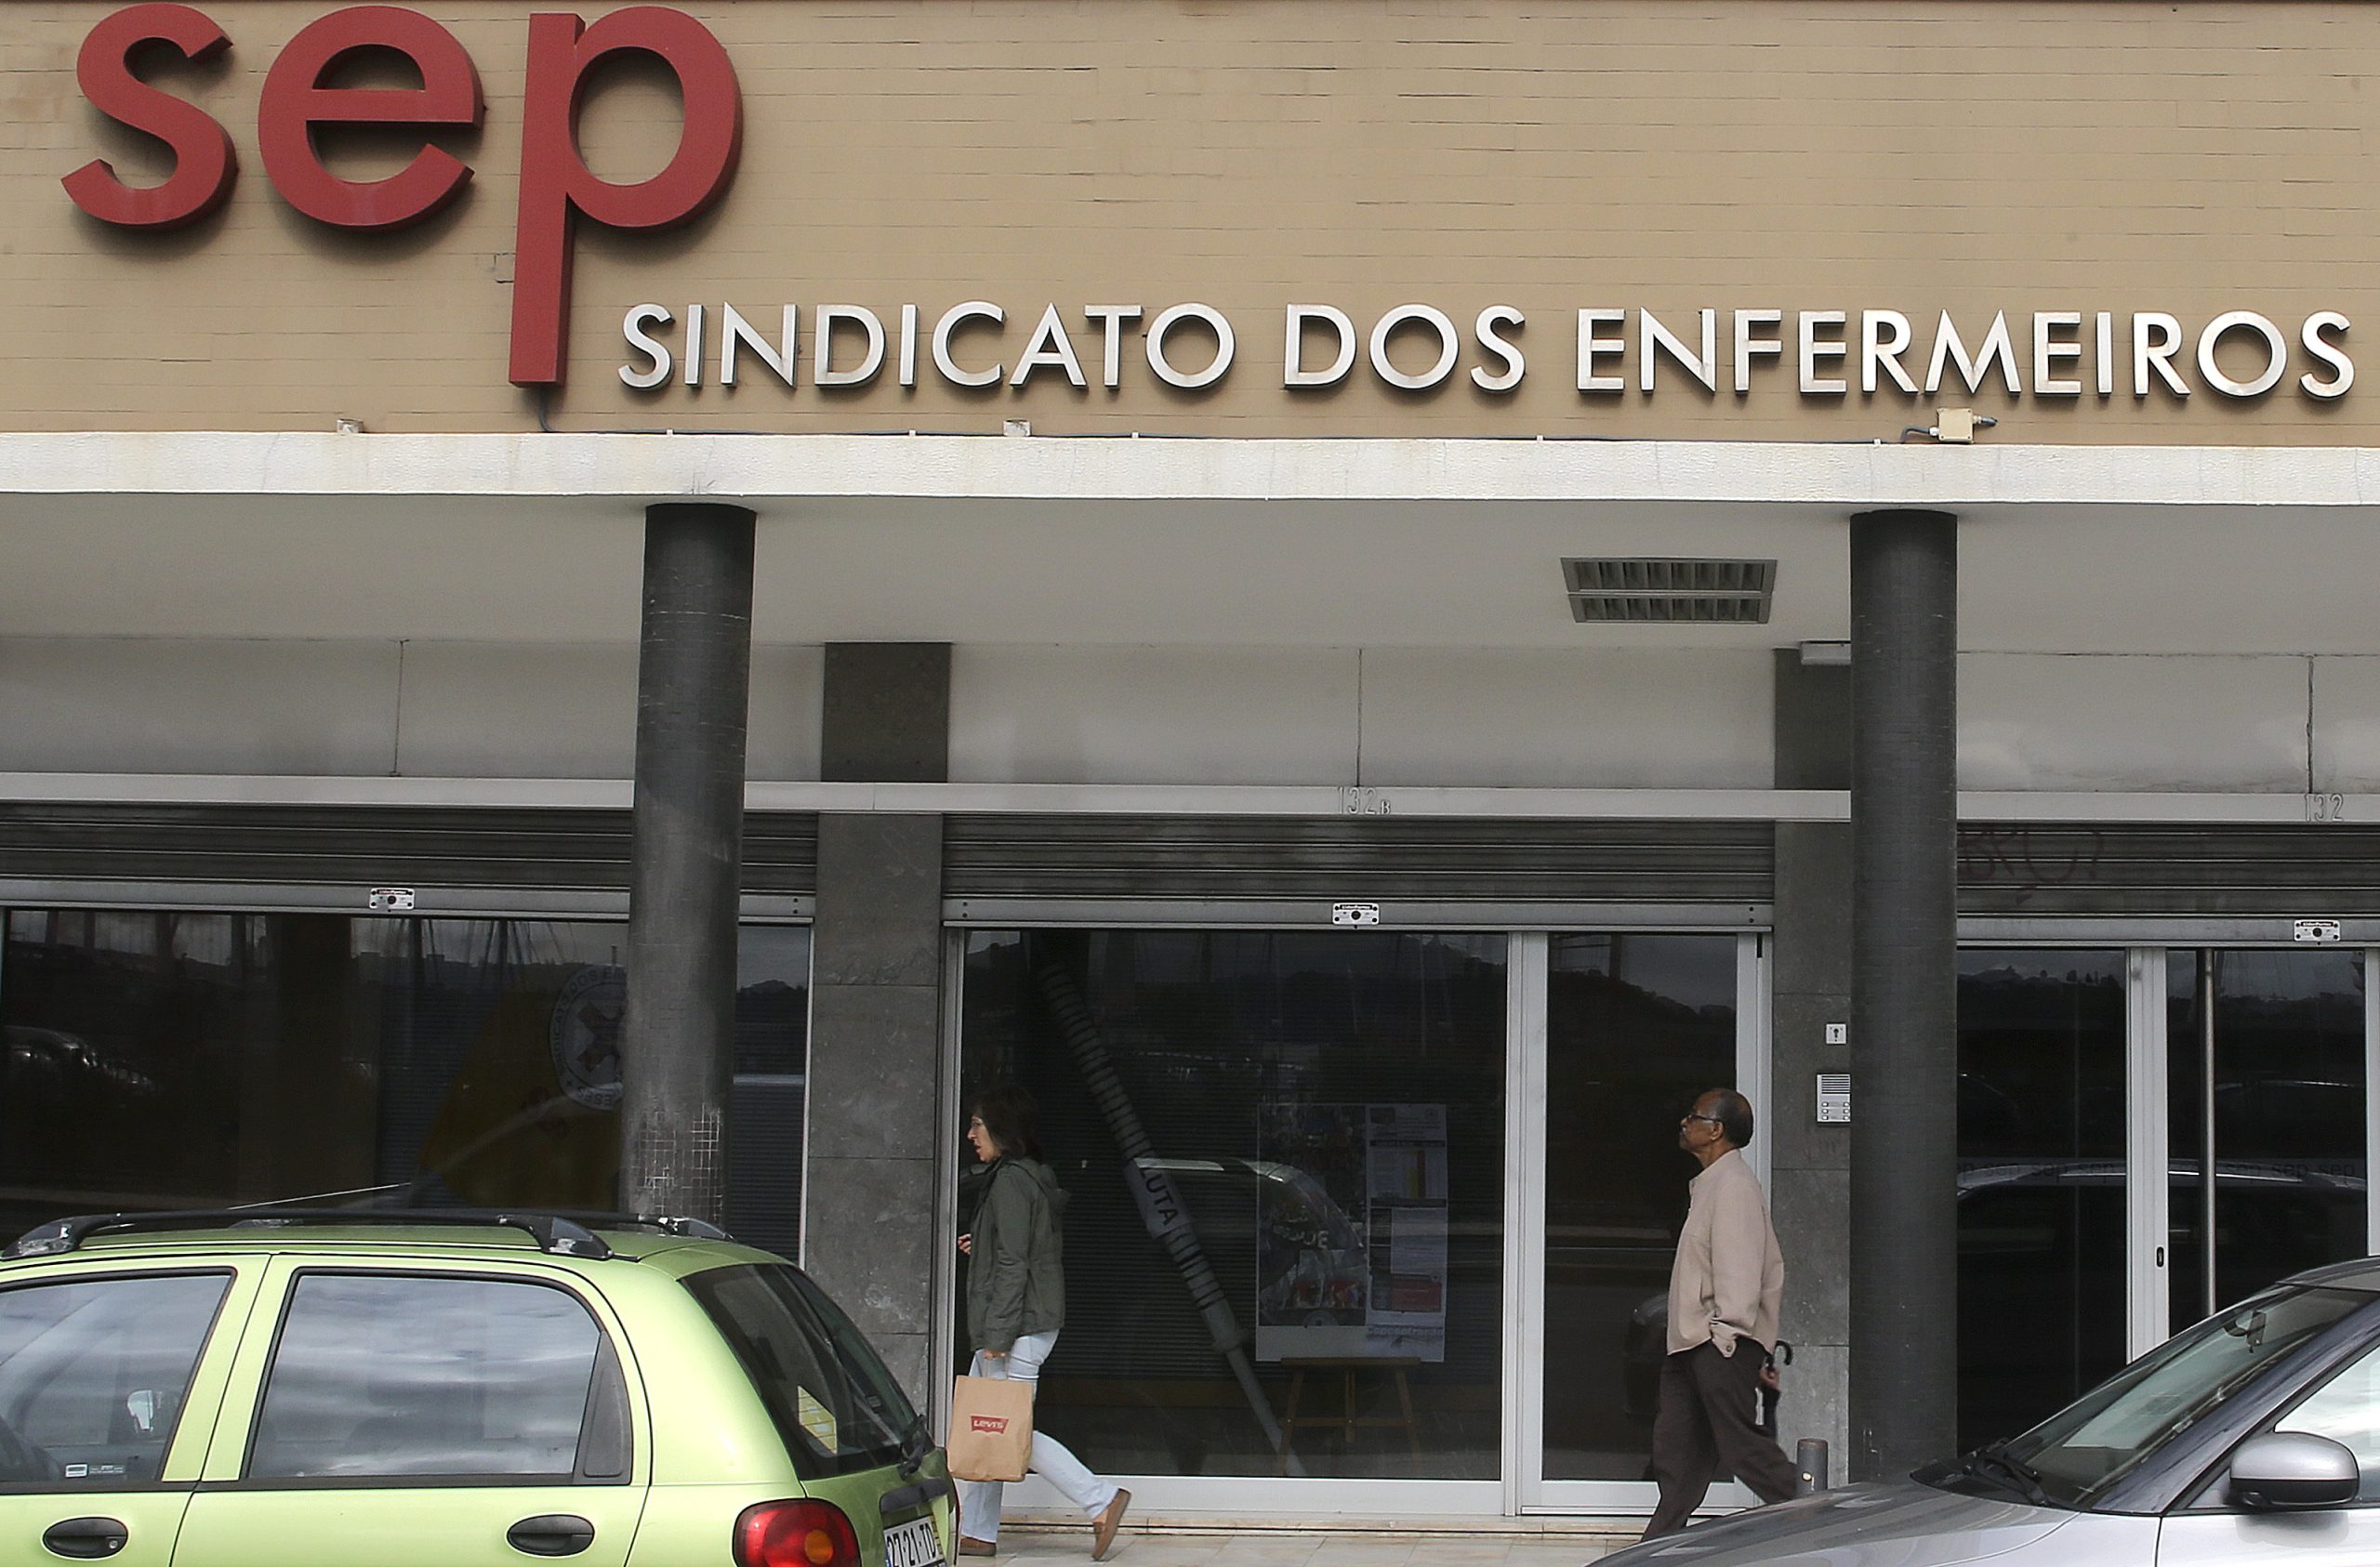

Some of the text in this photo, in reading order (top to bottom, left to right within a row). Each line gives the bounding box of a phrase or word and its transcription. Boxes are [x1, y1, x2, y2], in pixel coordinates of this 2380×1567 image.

[61, 3, 745, 388] sep
[618, 301, 2356, 400] SINDICATO DOS ENFERMEIROS
[2305, 793, 2344, 823] 132
[1139, 1167, 1179, 1226] LUTA
